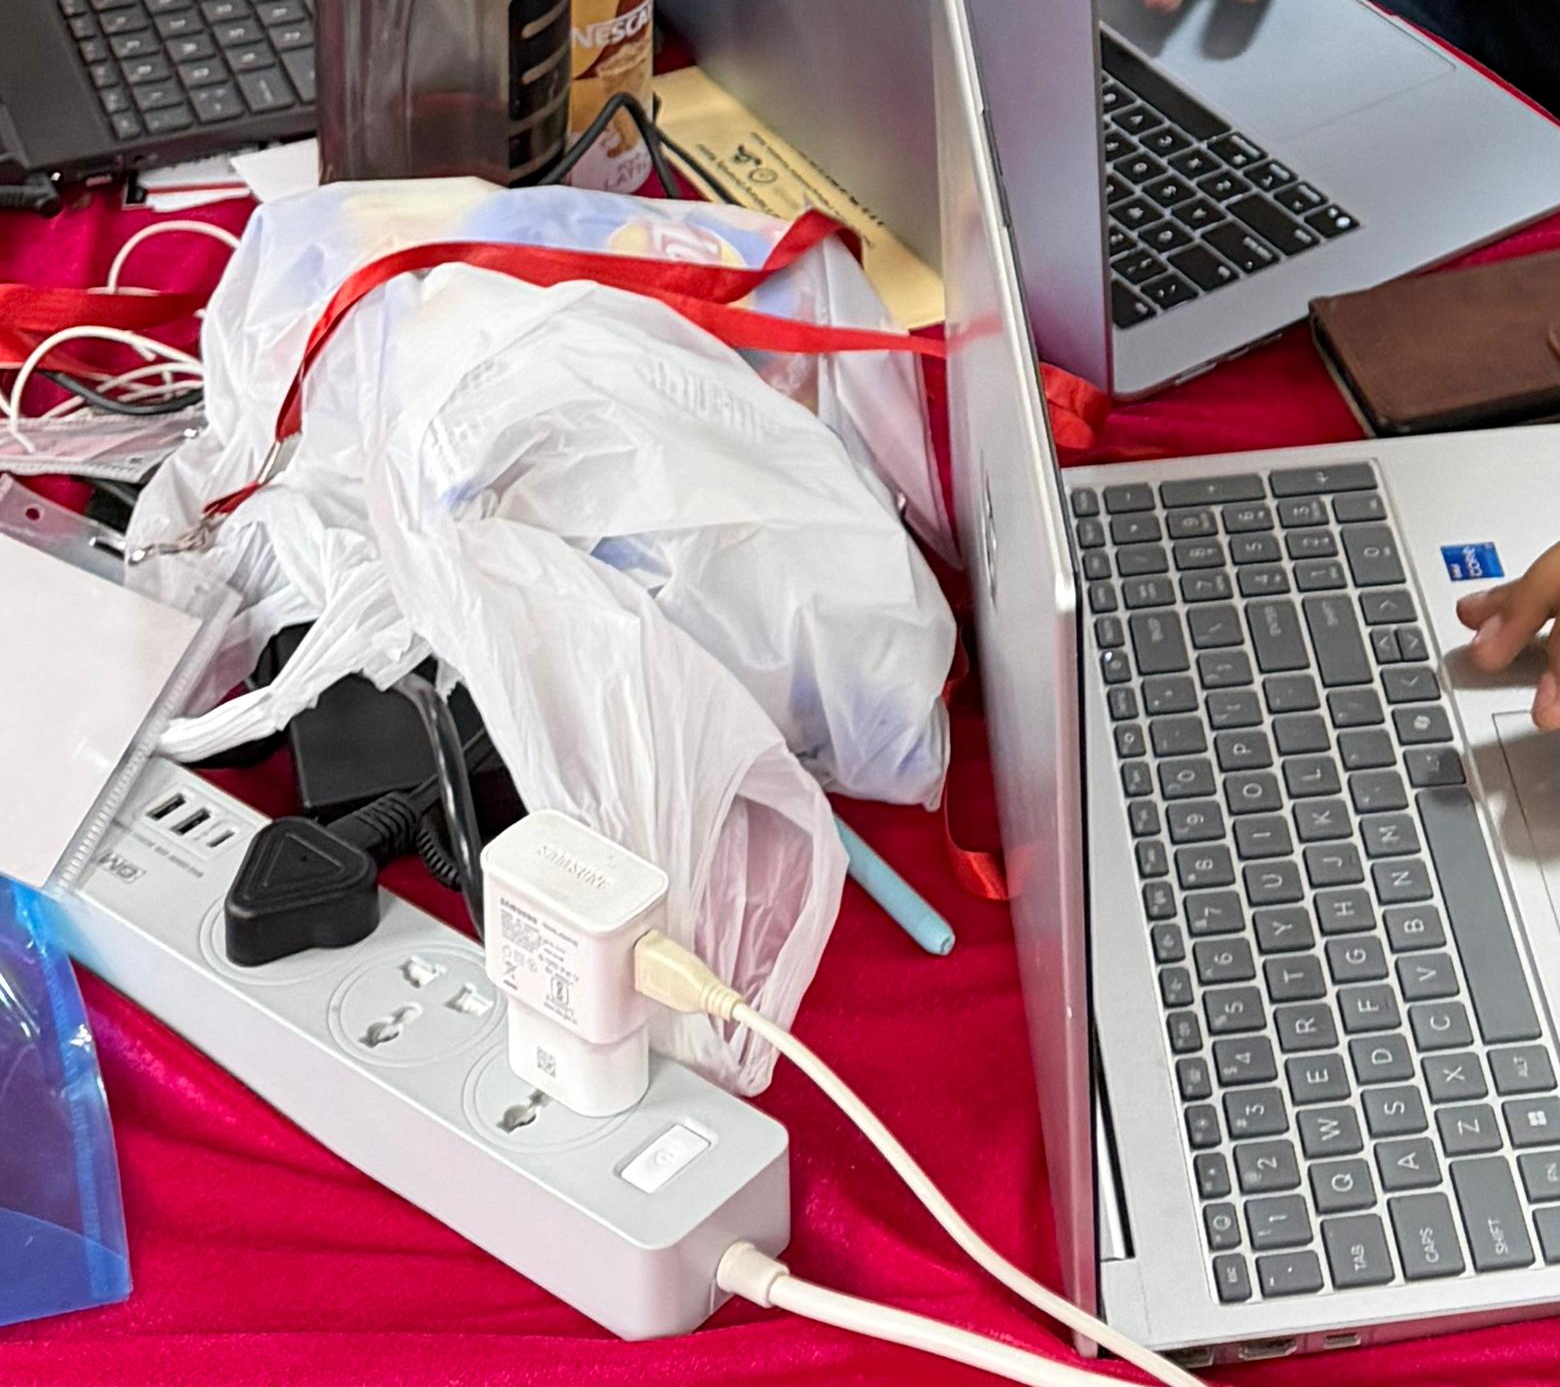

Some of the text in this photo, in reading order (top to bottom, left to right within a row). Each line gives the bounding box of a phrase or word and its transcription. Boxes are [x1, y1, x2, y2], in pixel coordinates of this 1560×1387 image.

[1232, 742, 1252, 757] P
[1301, 768, 1322, 780] L
[1312, 810, 1333, 826] K
[1322, 856, 1343, 868] J
[1262, 873, 1283, 889] U
[1391, 871, 1412, 887] N
[1333, 900, 1355, 916] H
[1272, 920, 1293, 936] Y
[1403, 918, 1425, 934] B
[1213, 951, 1234, 966] 6
[1345, 948, 1367, 965] G
[1283, 969, 1304, 984] T
[1415, 966, 1437, 982] V
[1224, 1001, 1244, 1015] 5
[1357, 997, 1380, 1013] F
[1295, 1017, 1318, 1035] R
[1429, 1015, 1451, 1031] C
[1371, 1048, 1393, 1065] D
[1306, 1068, 1329, 1084] E
[1442, 1066, 1466, 1082] X
[1244, 1103, 1265, 1116] 3
[1383, 1100, 1406, 1116] S
[1316, 1117, 1341, 1142] W
[1456, 1118, 1481, 1136] Z
[1256, 1155, 1278, 1170] 2
[1397, 1151, 1420, 1171] A
[1330, 1173, 1354, 1193] Q
[1419, 1226, 1440, 1264] CAPS
[1487, 1218, 1509, 1256] SHIFT
[1350, 1243, 1368, 1272] TAB
